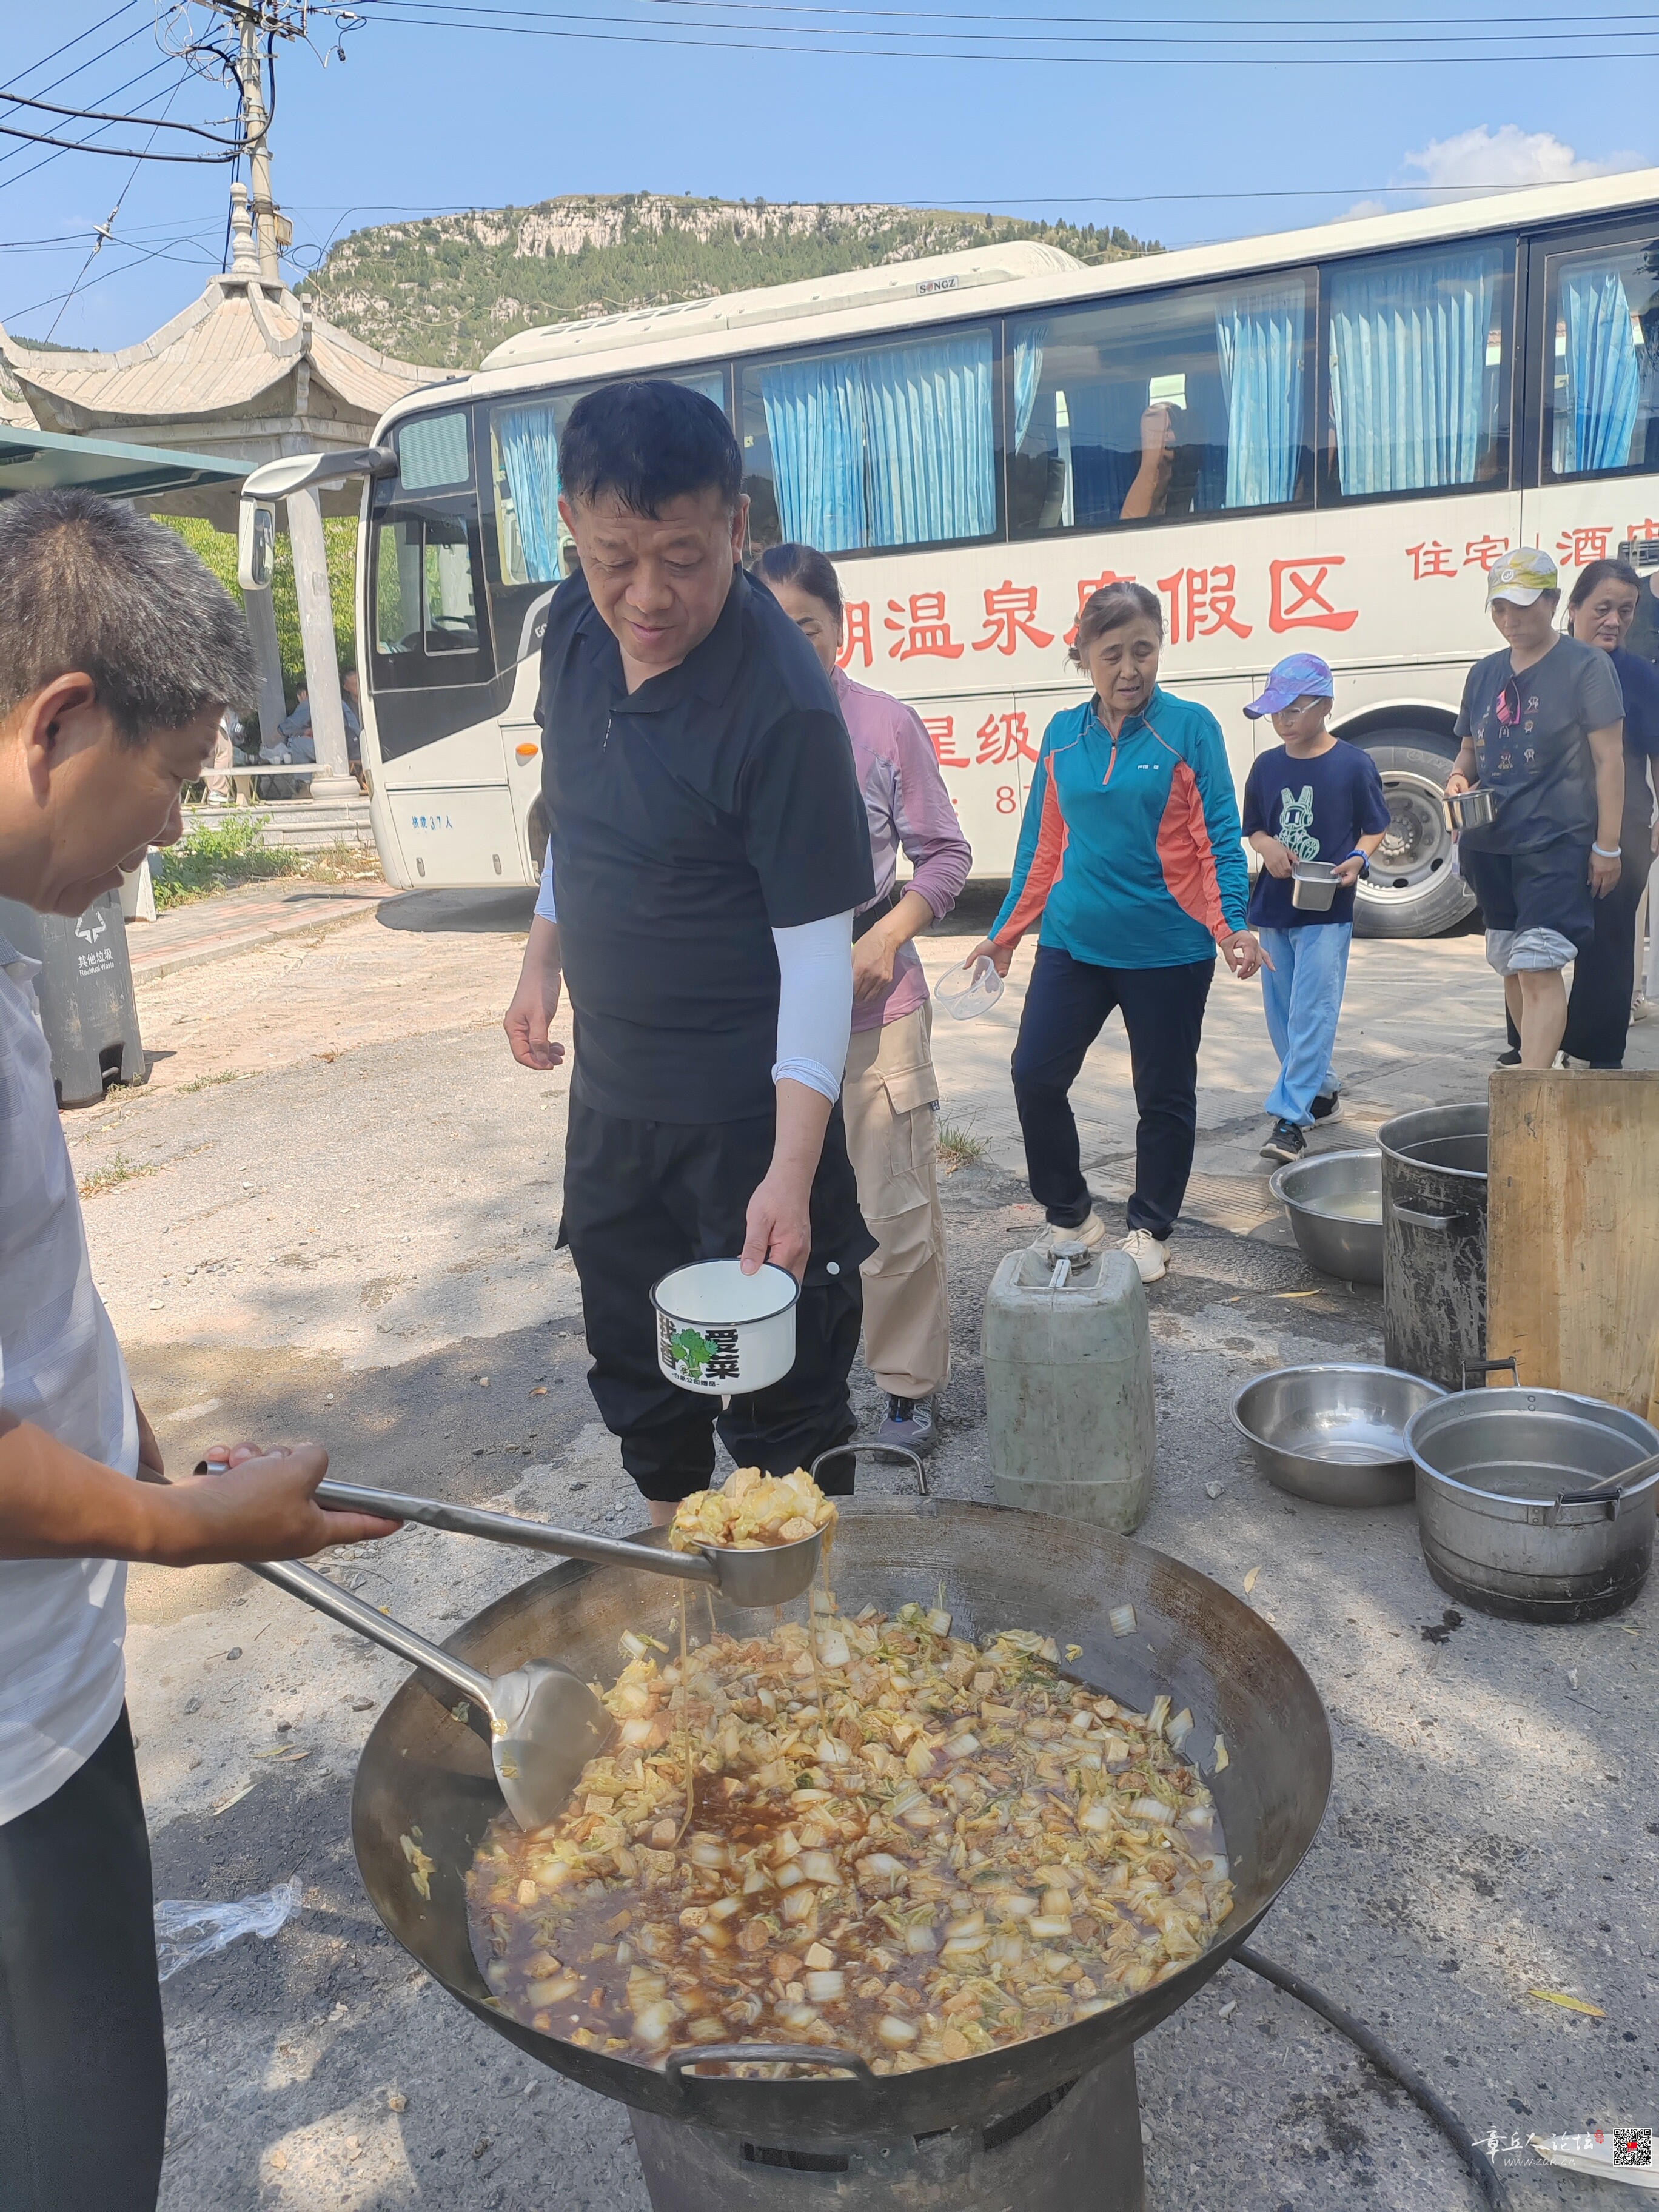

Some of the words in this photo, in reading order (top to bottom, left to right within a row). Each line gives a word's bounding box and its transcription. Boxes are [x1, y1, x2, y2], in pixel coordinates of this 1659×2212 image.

[919, 278, 956, 294] SONGZ
[78, 948, 113, 968] 其他垃圾
[79, 964, 101, 977] Residual
[101, 962, 115, 970] Waste
